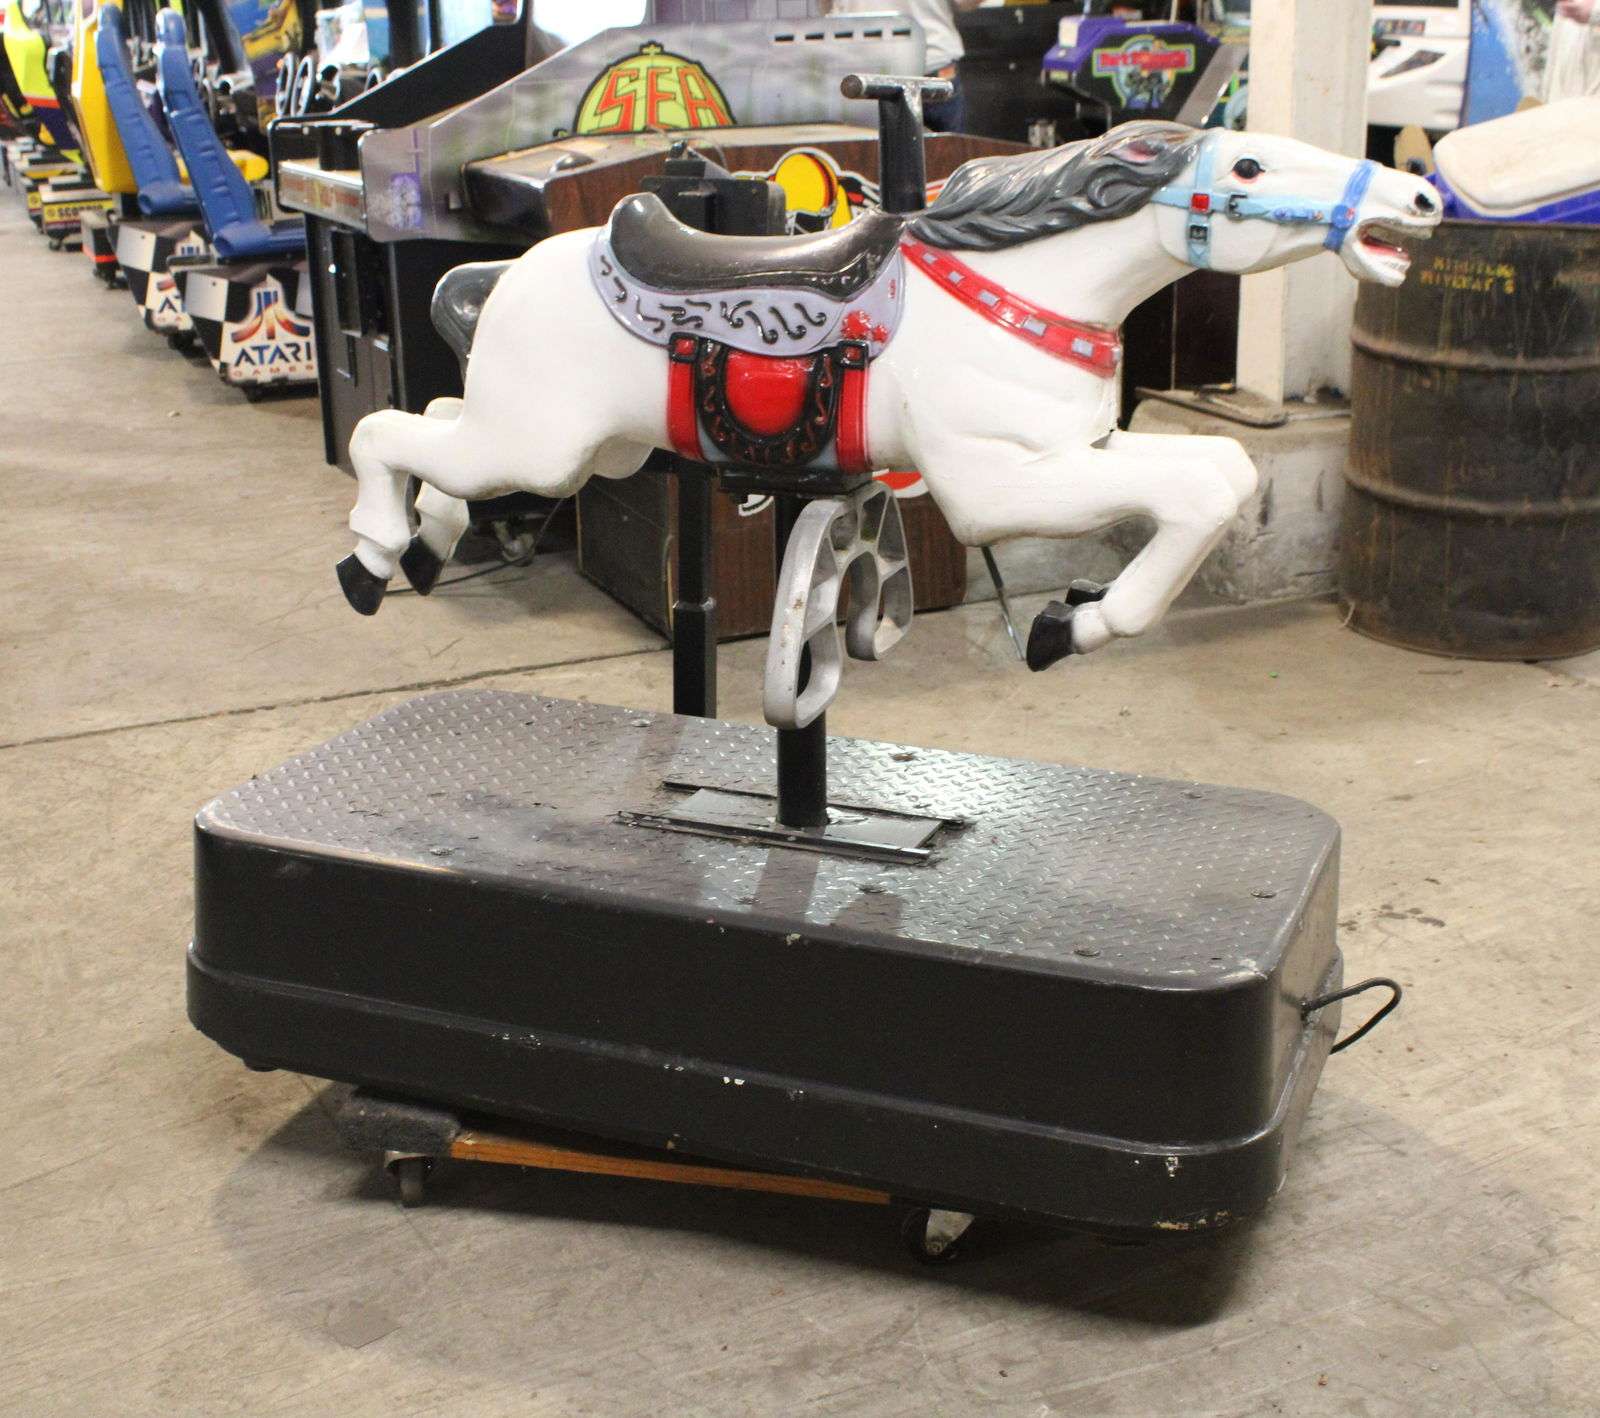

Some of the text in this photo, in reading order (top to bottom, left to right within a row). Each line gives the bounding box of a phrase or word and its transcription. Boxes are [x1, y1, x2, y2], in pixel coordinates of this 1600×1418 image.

[588, 67, 730, 132] SEA
[234, 341, 312, 367] ATARI
[233, 364, 315, 377] GAMES
